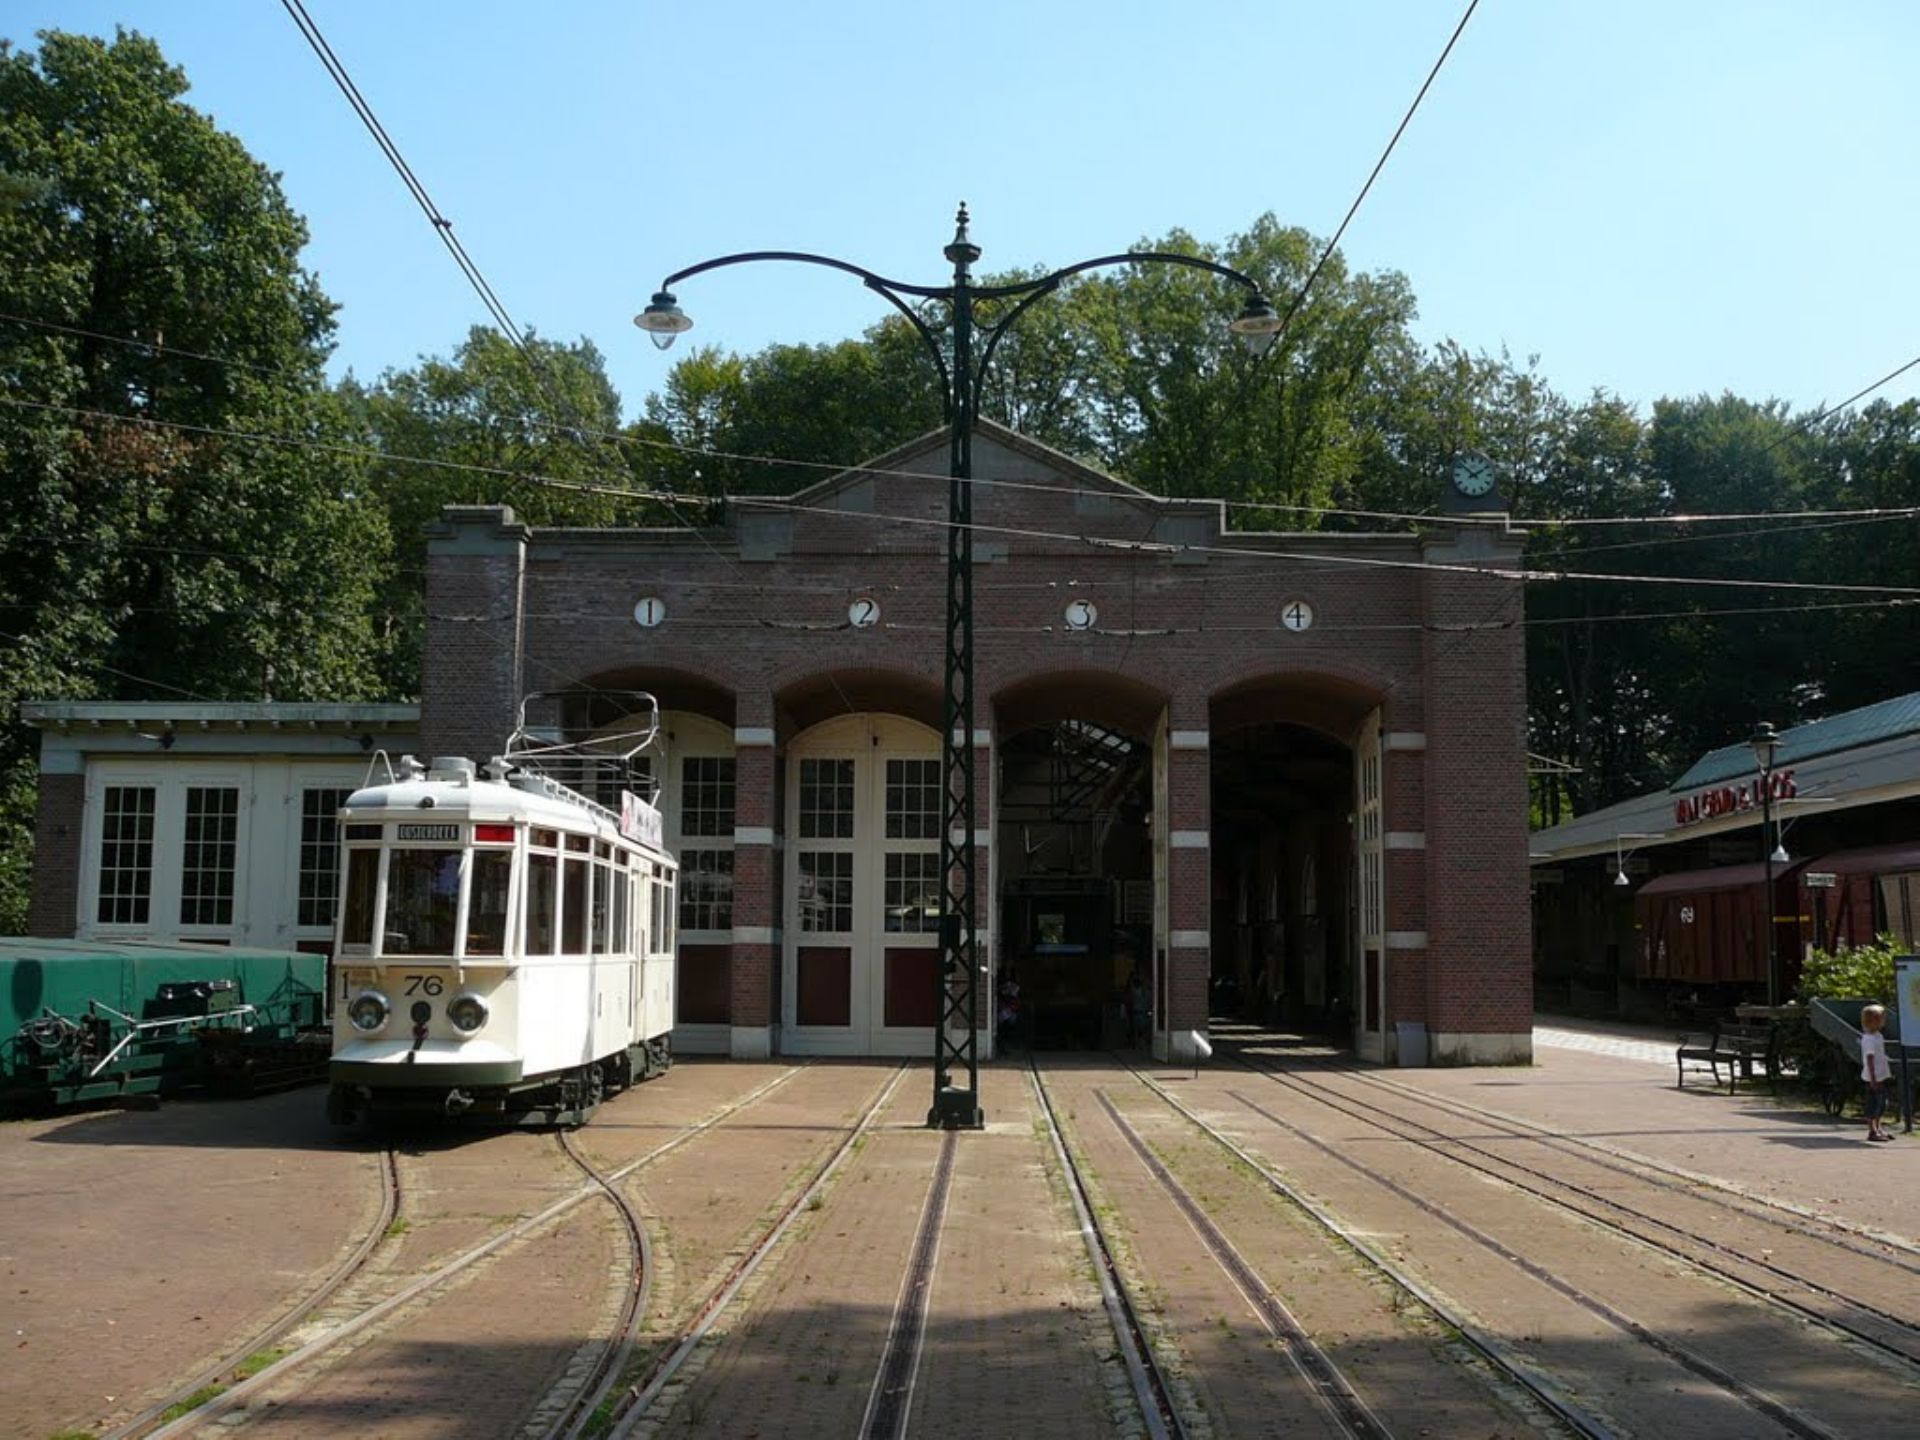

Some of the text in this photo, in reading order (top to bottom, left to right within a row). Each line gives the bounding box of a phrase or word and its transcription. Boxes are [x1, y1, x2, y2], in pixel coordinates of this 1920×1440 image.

[855, 599, 875, 625] 2
[1070, 602, 1091, 628] 3
[1285, 602, 1306, 628] 4
[404, 975, 444, 996] 76
